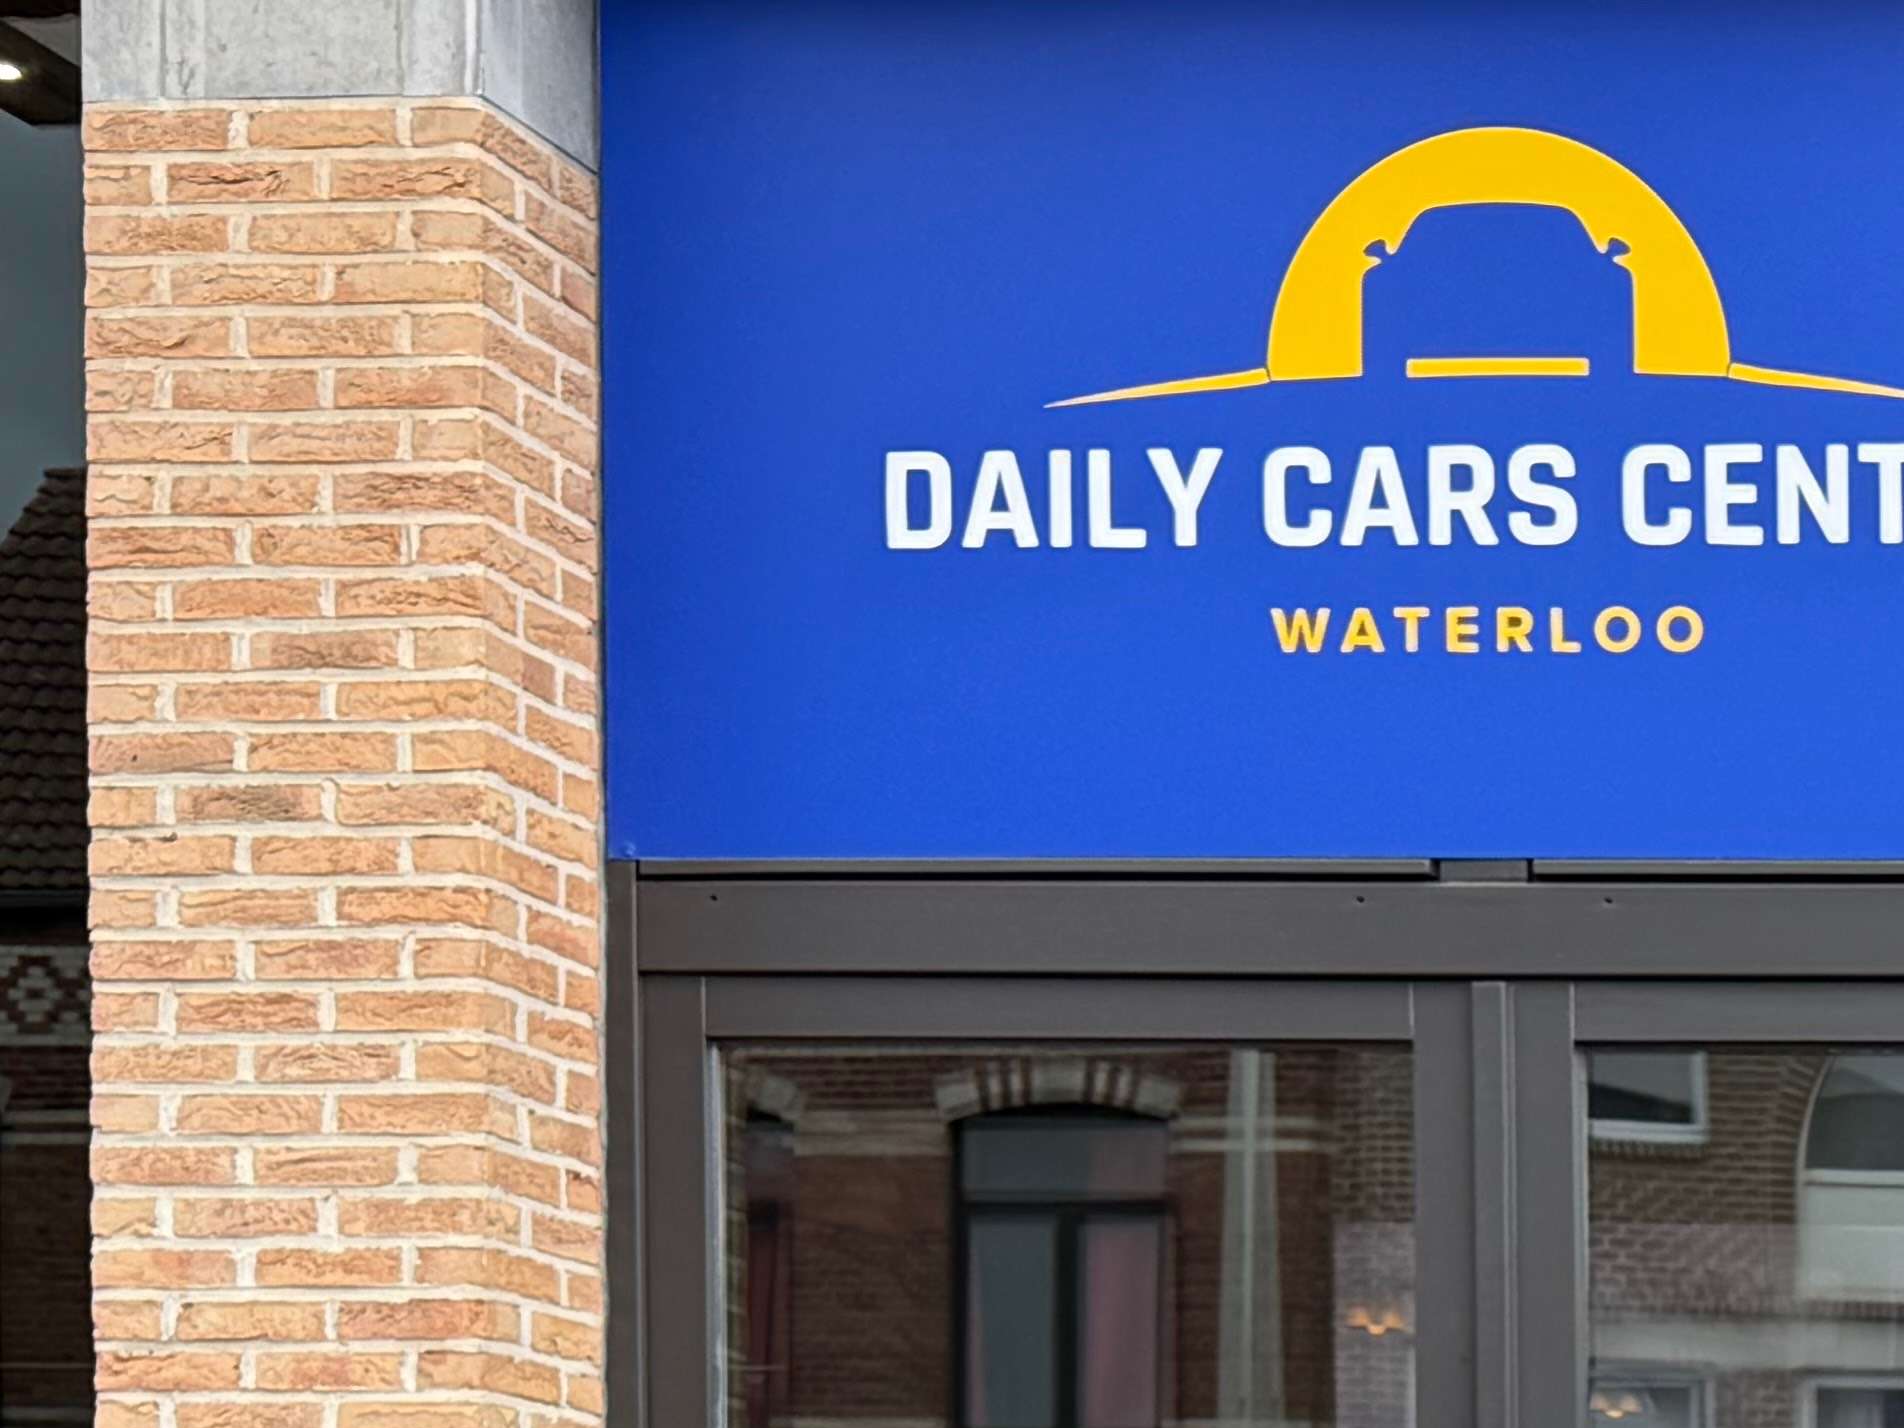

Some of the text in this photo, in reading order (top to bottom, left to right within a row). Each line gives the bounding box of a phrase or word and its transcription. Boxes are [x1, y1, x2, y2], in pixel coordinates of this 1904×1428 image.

[885, 447, 1222, 549] DAILY
[1262, 444, 1578, 546] CARS
[1270, 606, 1706, 654] WATERLOO
